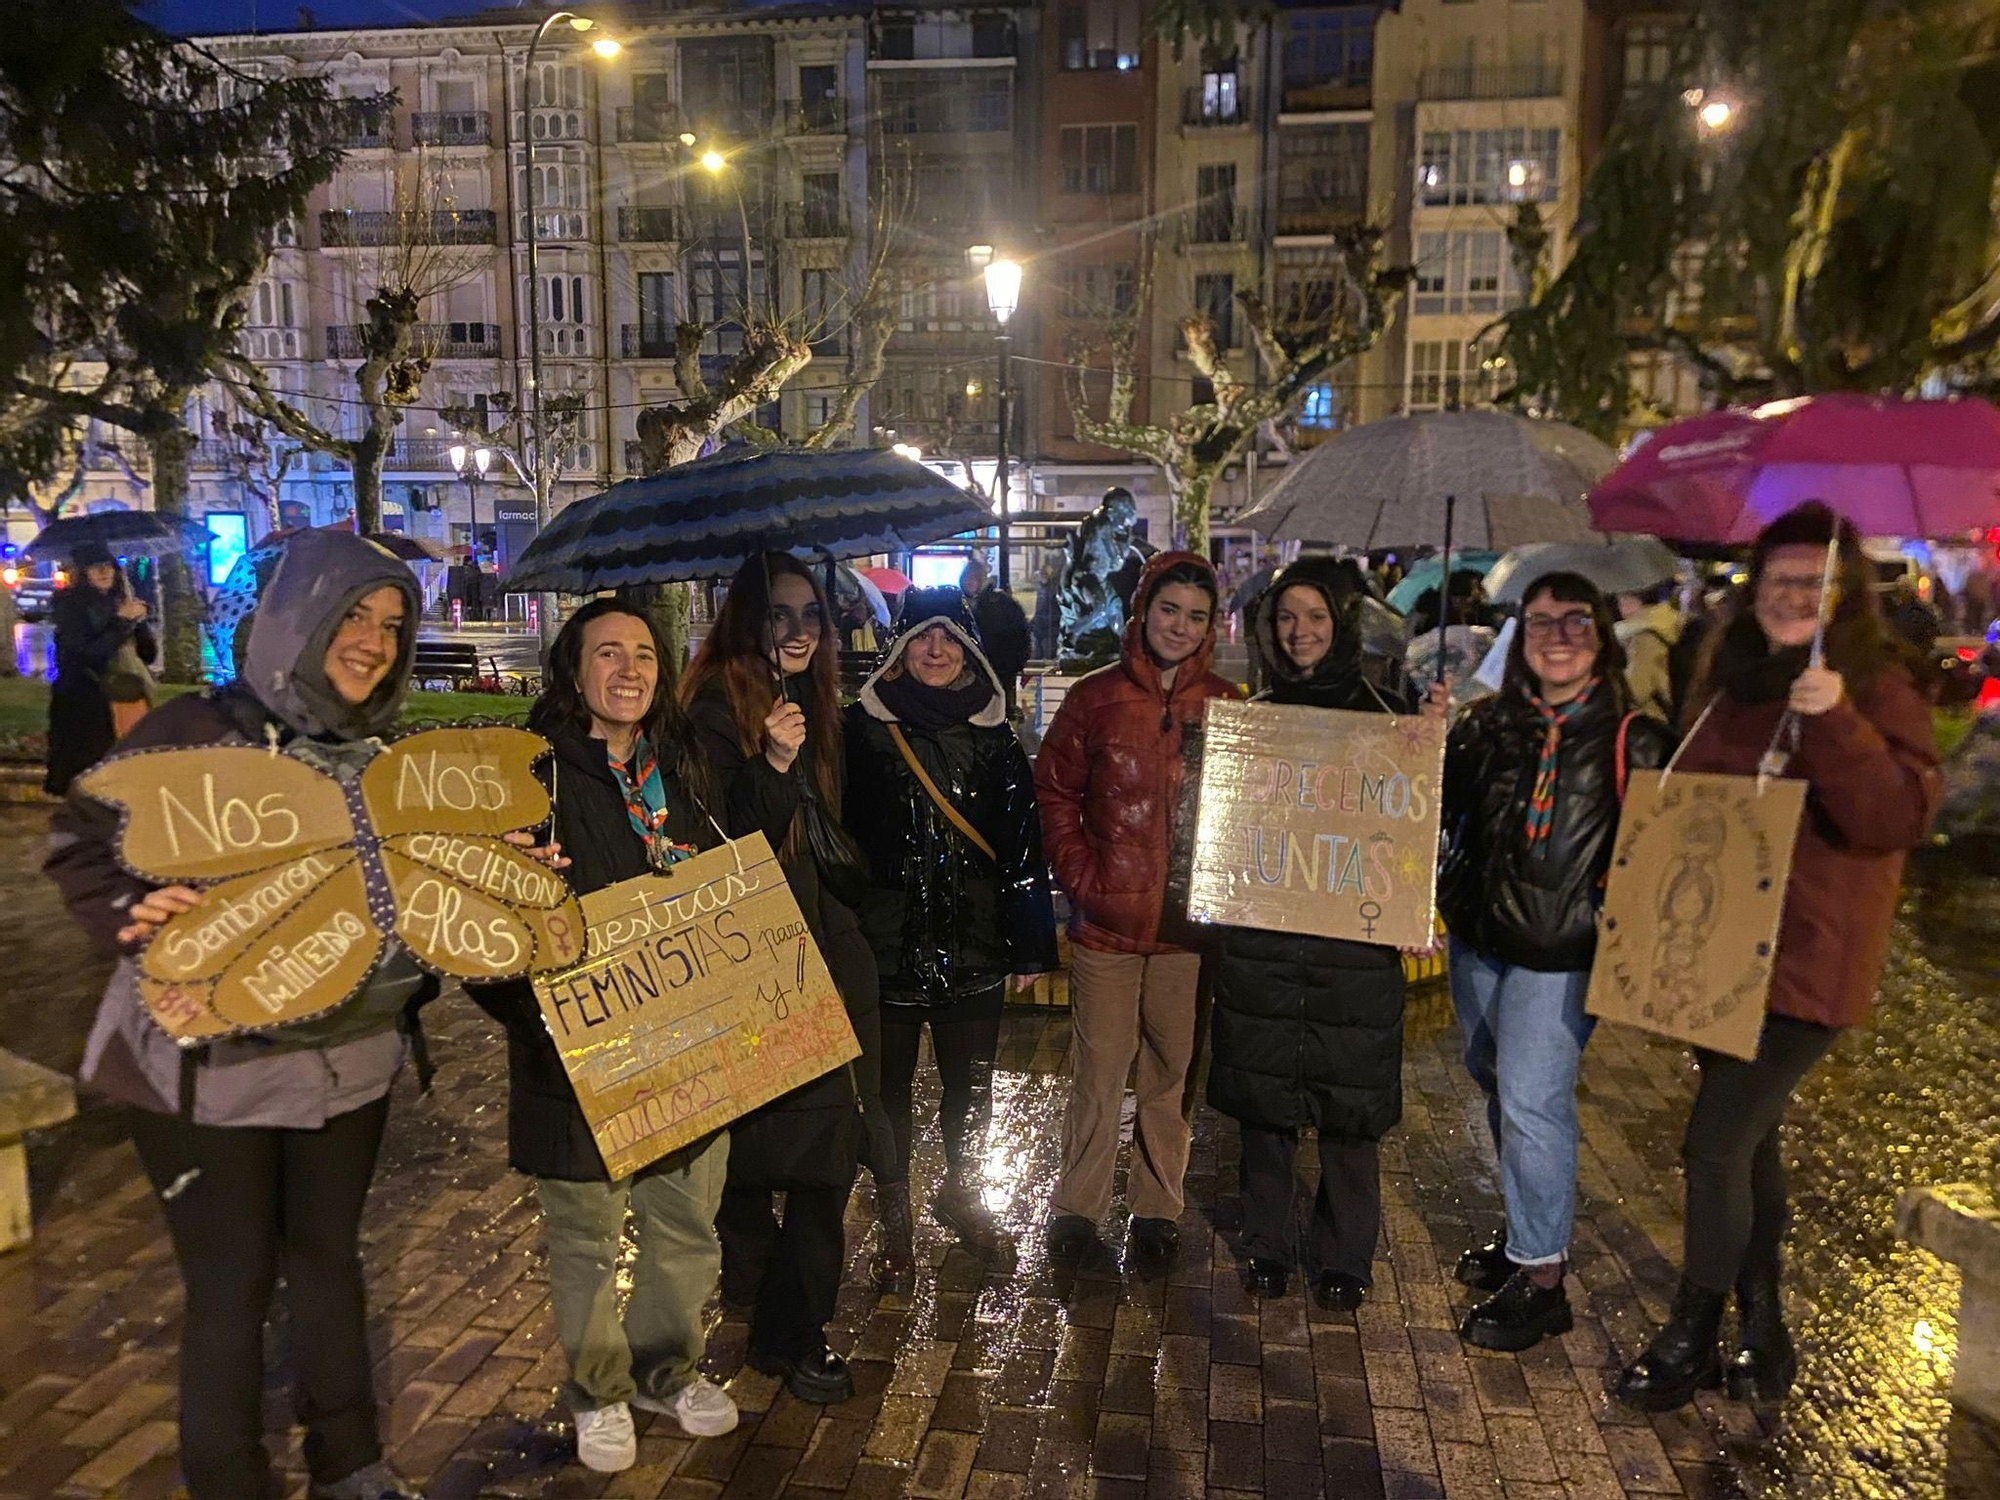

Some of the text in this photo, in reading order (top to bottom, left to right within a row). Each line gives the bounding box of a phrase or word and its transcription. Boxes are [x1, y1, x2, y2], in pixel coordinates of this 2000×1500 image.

[498, 509, 538, 521] farmaci
[402, 880, 520, 968] Alas
[586, 872, 760, 957] aestras
